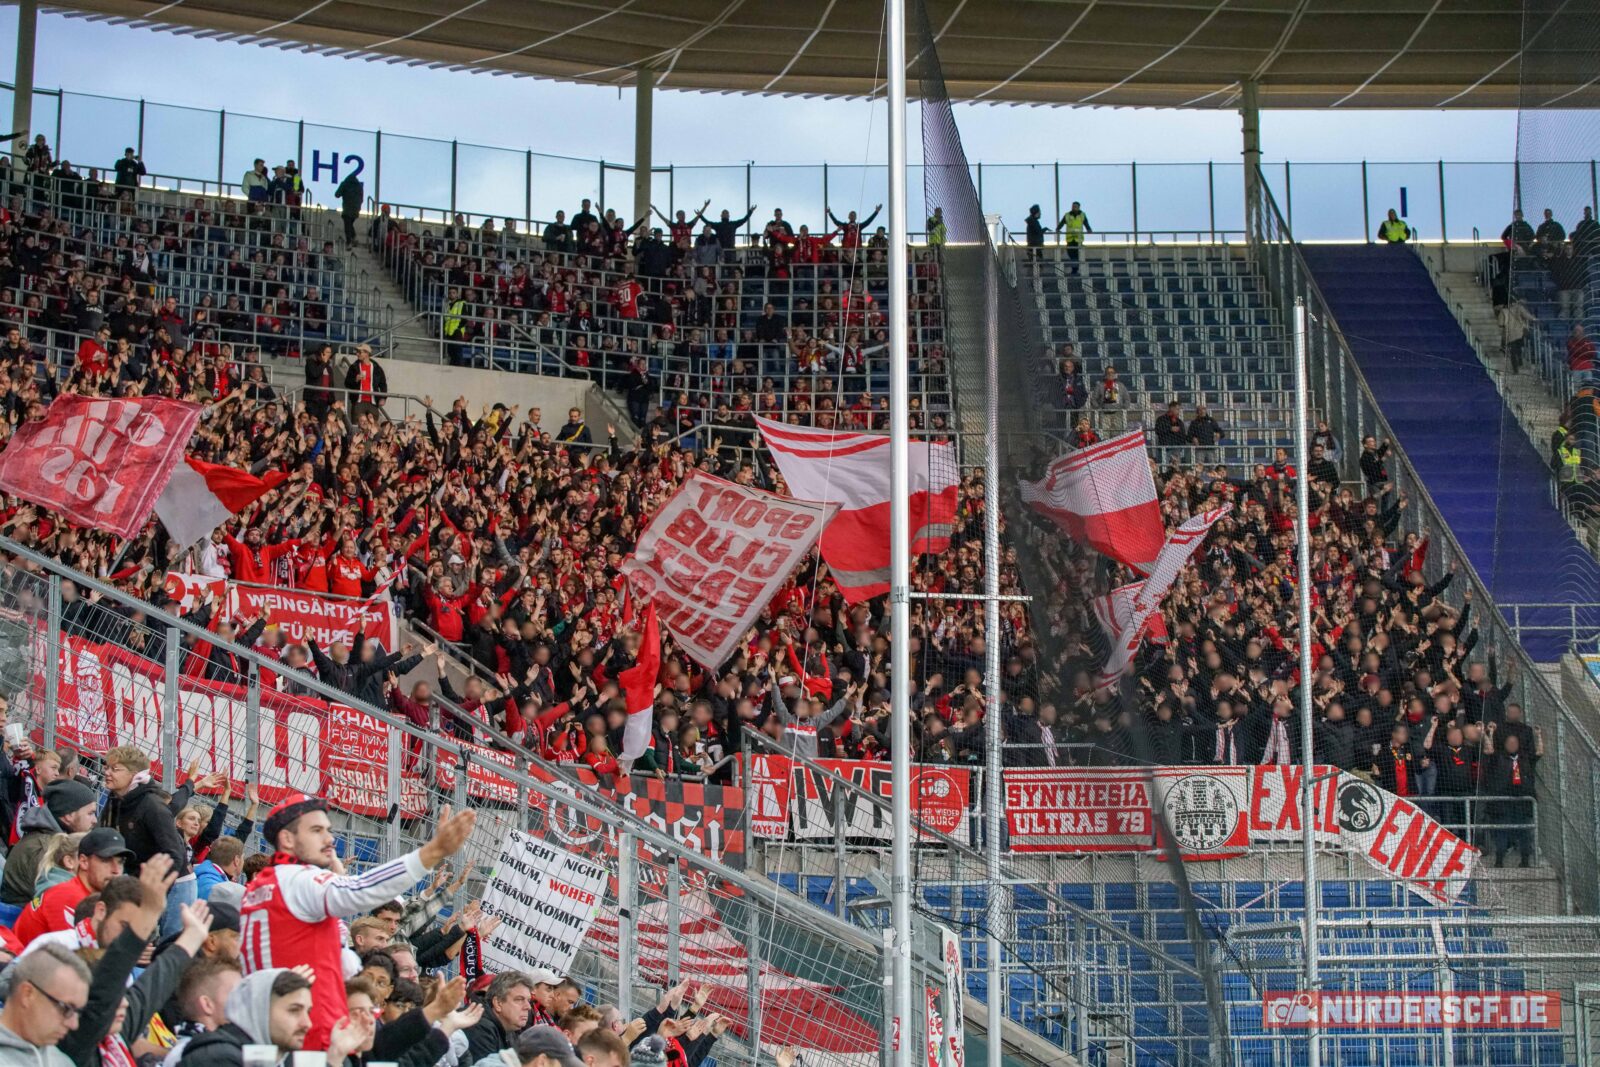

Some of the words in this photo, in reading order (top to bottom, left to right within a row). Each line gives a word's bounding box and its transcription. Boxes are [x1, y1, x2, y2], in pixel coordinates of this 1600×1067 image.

[312, 149, 365, 185] H2
[331, 726, 360, 745] FÜR
[1007, 782, 1149, 808] SYNTHESIA
[934, 808, 960, 818] WIEDER
[1013, 812, 1108, 835] ULTRAS
[1116, 811, 1145, 833] 79
[509, 828, 522, 843] ES
[525, 841, 559, 863] GEHT
[563, 858, 606, 881] NICHT
[500, 851, 542, 885] DARUM,
[549, 878, 596, 907] WOHER
[491, 877, 535, 907] JEMAND
[534, 899, 584, 933] KOMMT,
[480, 900, 495, 916] ES
[495, 908, 525, 932] GEHT
[525, 924, 573, 958] DARUM,
[491, 936, 537, 968] JEMAND
